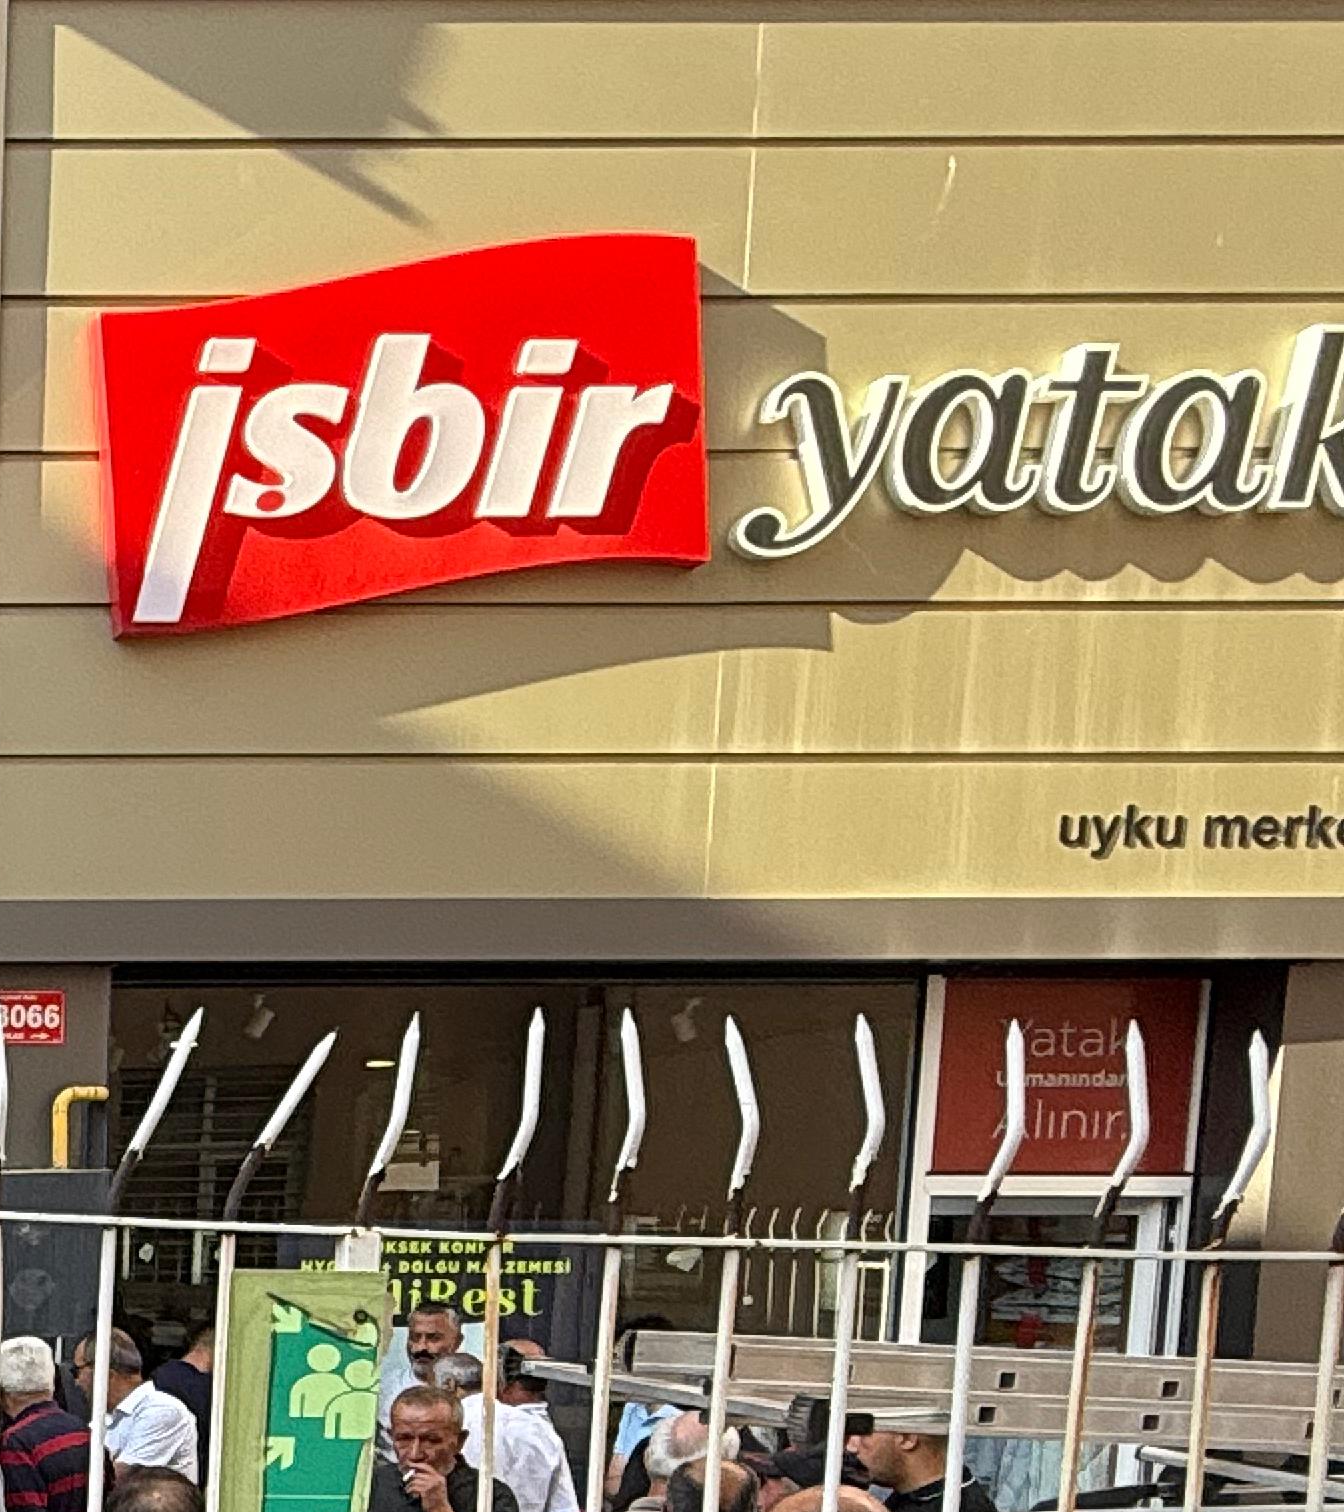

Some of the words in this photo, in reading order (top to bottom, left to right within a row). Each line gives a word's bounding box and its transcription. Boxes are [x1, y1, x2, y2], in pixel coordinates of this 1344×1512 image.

[1060, 806, 1186, 859] uyku
[1203, 804, 1344, 850] merk
[398, 1260, 460, 1274] DOLGU
